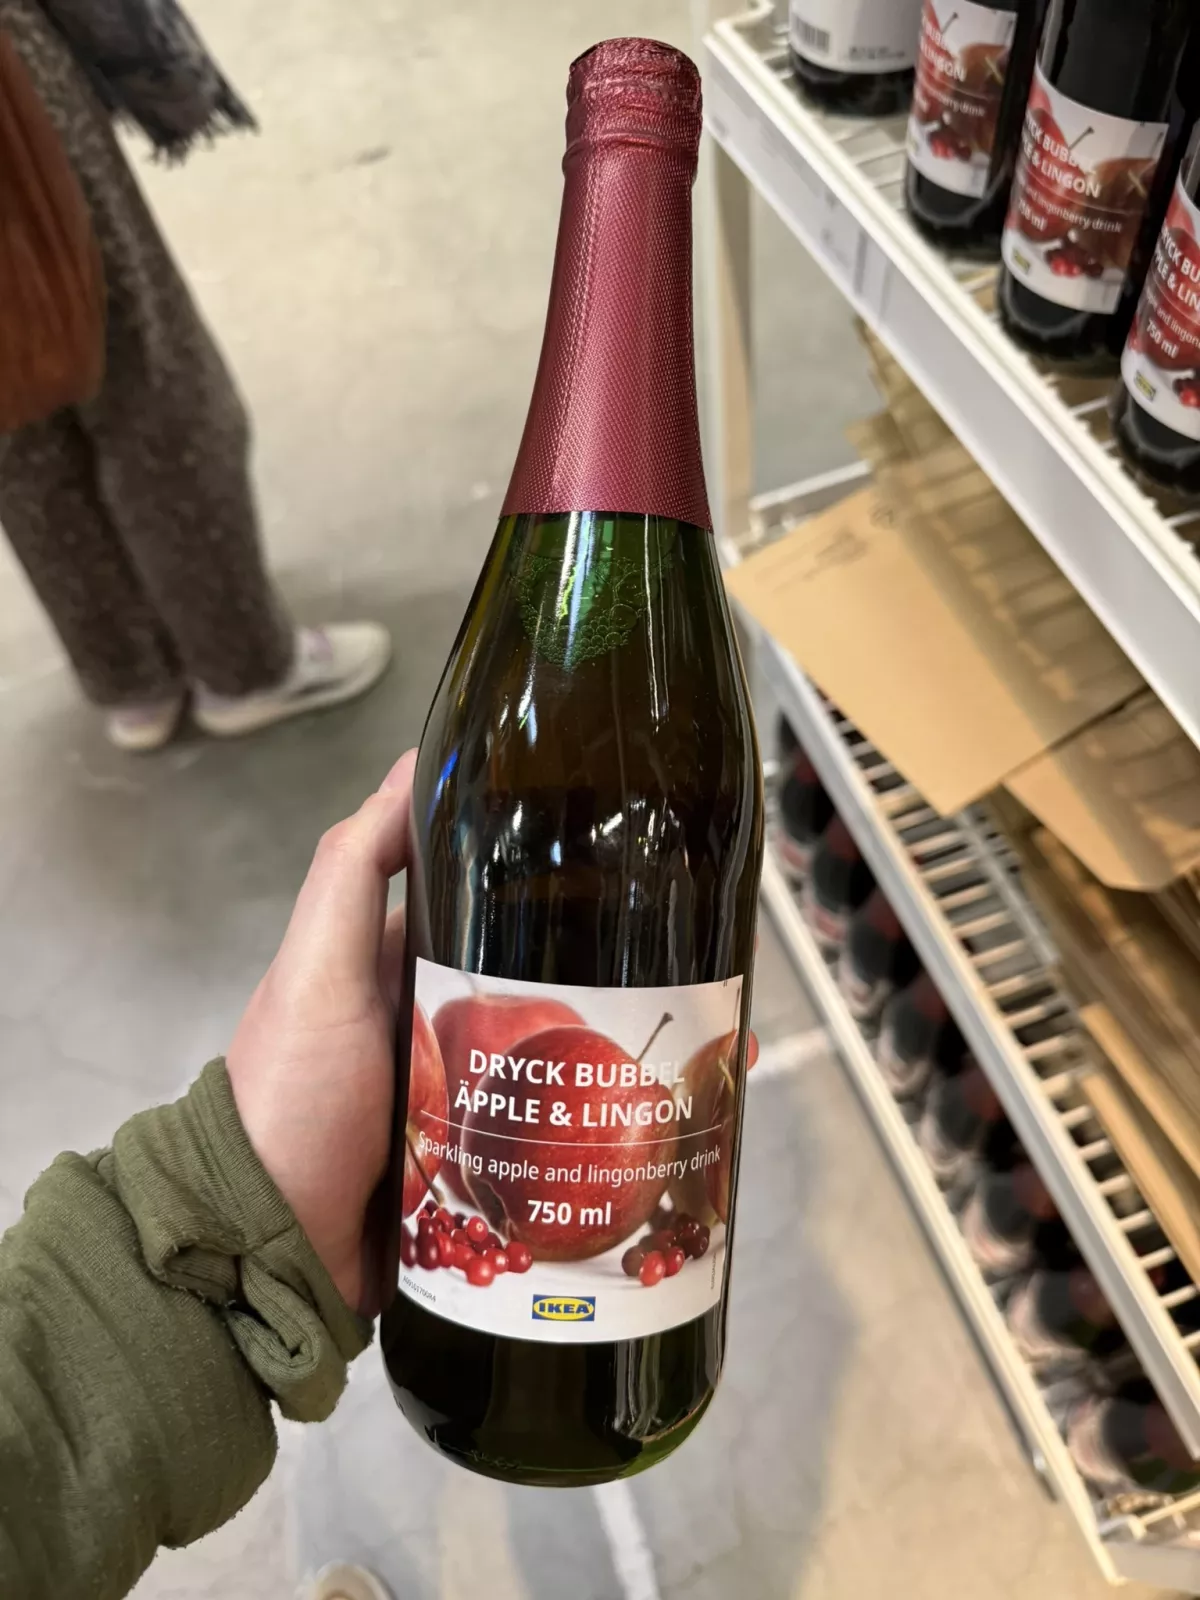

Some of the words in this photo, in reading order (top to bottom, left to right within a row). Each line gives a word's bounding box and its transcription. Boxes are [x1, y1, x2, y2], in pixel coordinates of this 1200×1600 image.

[1041, 157, 1102, 199] LINGON
[1167, 272, 1178, 292] &
[1146, 318, 1162, 345] 750
[1161, 339, 1180, 360] ml
[468, 1048, 566, 1087] DRYCK
[575, 1060, 685, 1089] BUBBEL
[454, 1079, 541, 1125] ÄPPLE
[549, 1101, 572, 1127] &
[582, 1096, 693, 1128] LINGON
[418, 1131, 483, 1175] Sparkling
[487, 1159, 540, 1183] apple
[544, 1164, 582, 1183] and
[587, 1158, 688, 1188] lingonberry
[690, 1144, 721, 1172] drink
[527, 1199, 572, 1225] 750
[579, 1201, 611, 1225] ml
